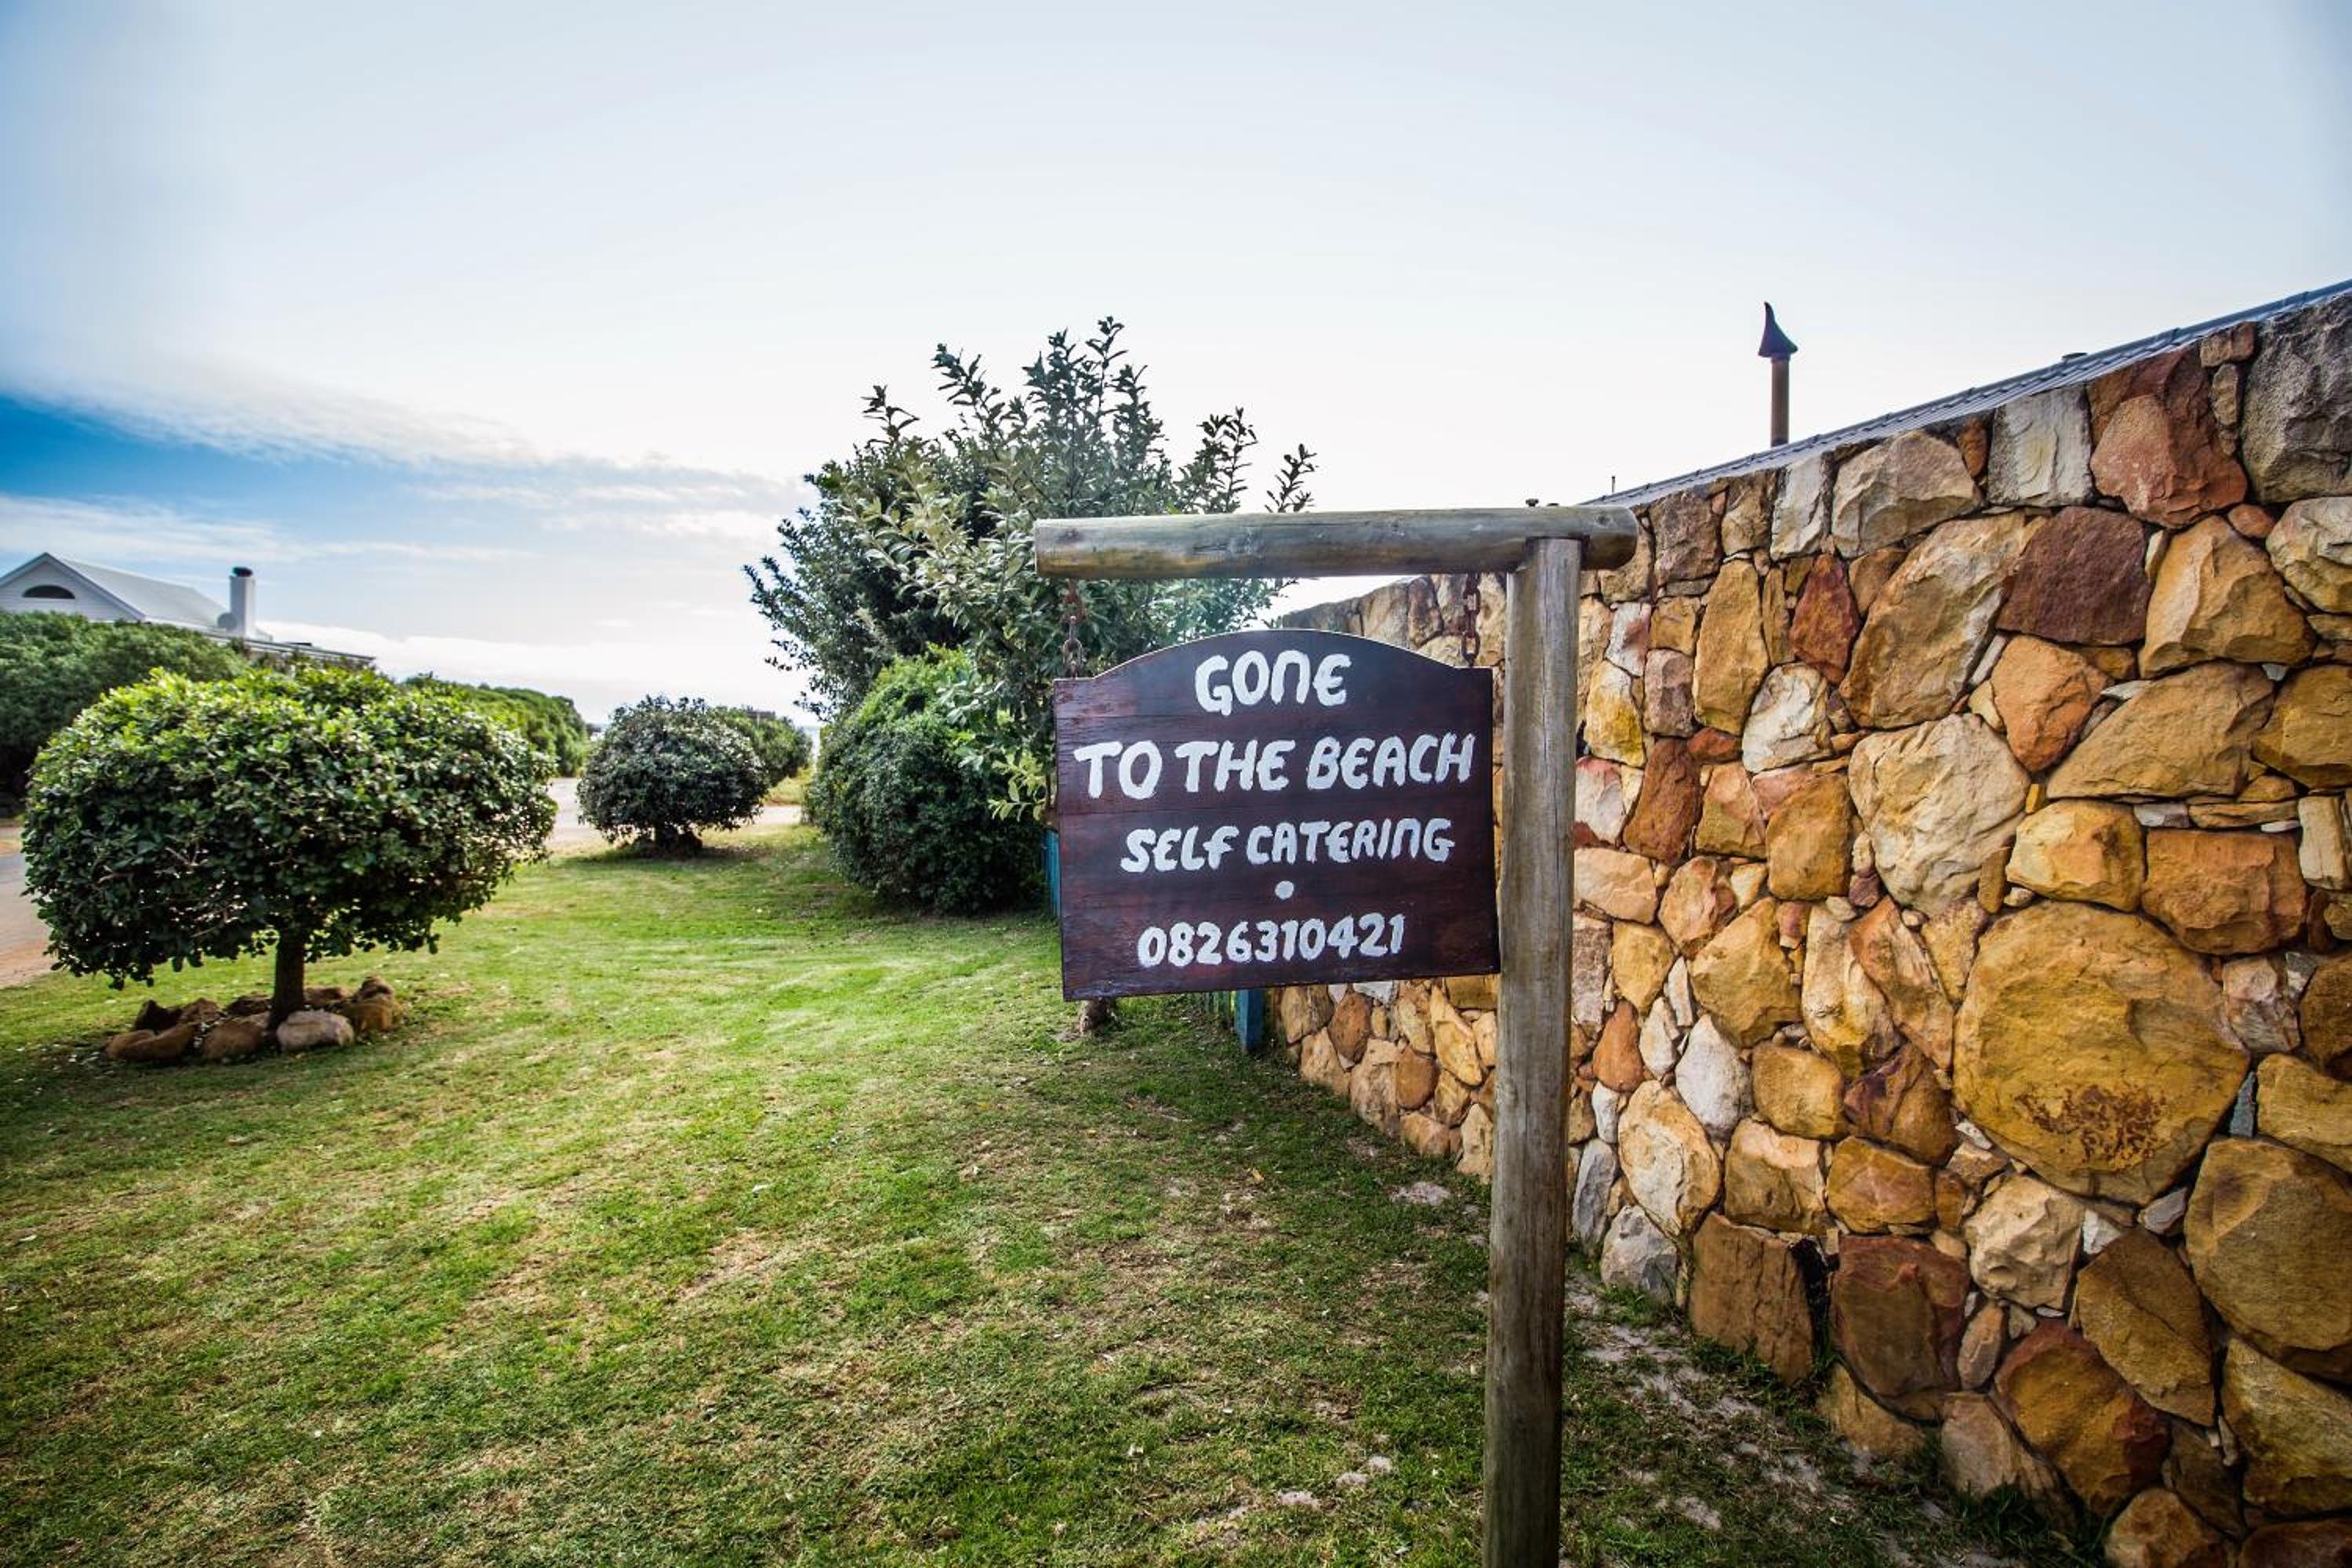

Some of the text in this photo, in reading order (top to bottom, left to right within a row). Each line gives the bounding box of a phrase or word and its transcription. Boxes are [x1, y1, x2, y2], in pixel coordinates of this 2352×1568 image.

[1194, 649, 1352, 717] GONE
[1073, 731, 1475, 800] TO THE BEACH
[1120, 818, 1455, 873] SELF CATERING
[1137, 913, 1406, 968] 0826310421
